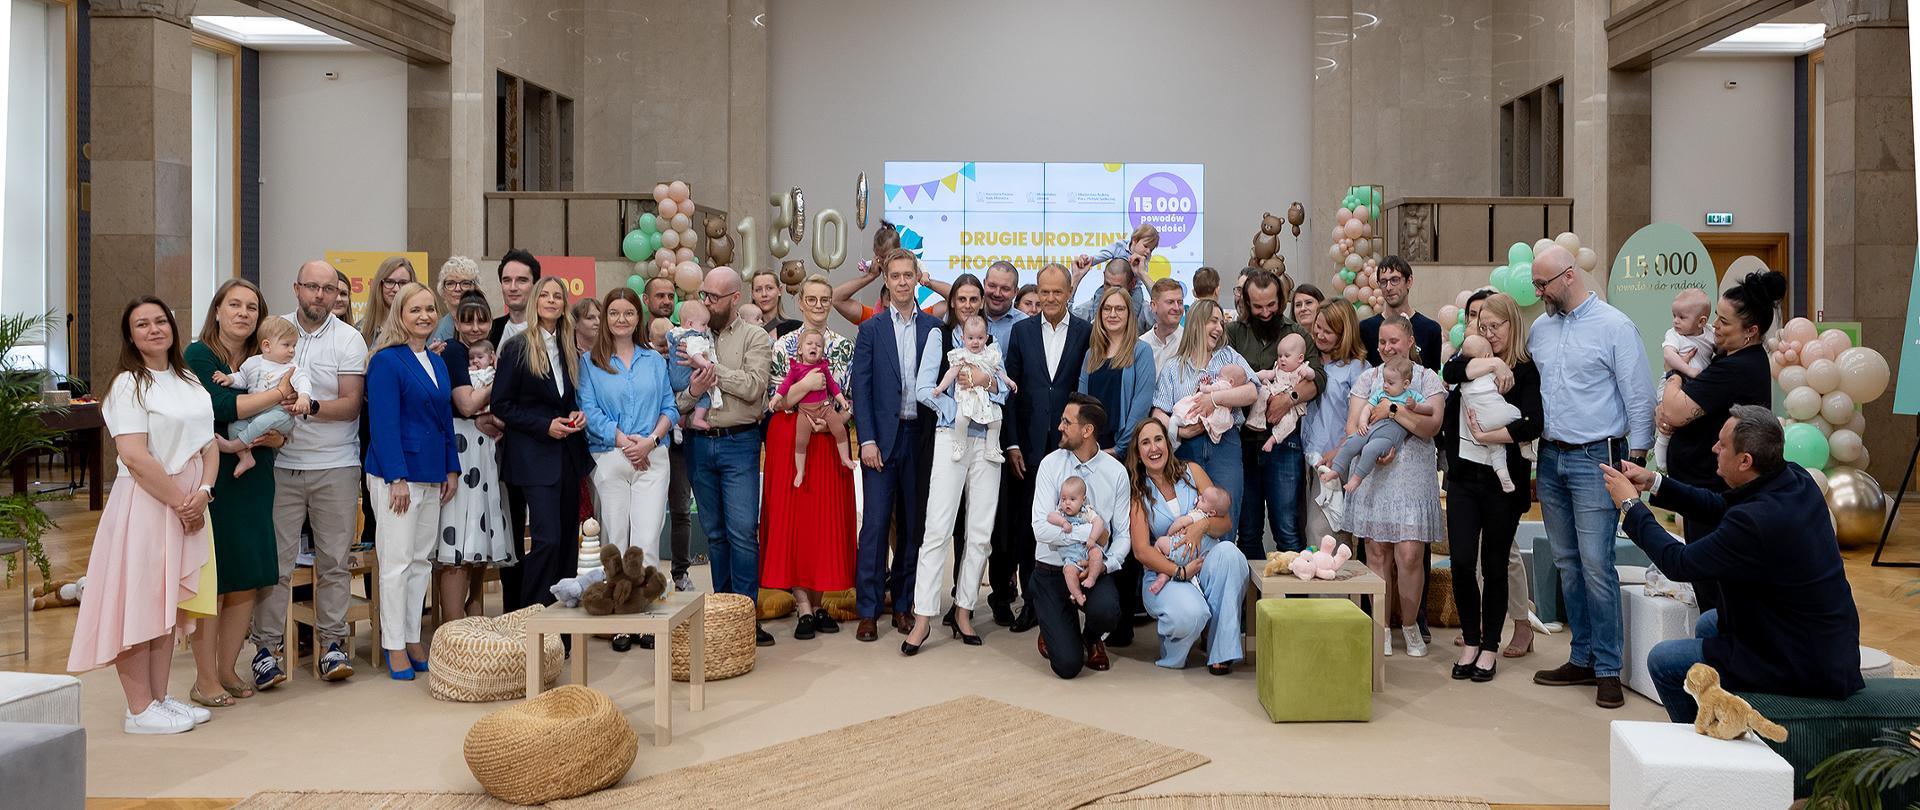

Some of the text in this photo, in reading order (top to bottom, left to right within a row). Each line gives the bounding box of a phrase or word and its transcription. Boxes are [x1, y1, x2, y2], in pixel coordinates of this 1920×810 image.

[1133, 196, 1153, 213] 15
[1156, 196, 1192, 213] 000
[1140, 213, 1185, 225] powodów
[1155, 223, 1187, 233] adości
[959, 231, 1129, 247] DRUGIE URODZINY
[1621, 251, 1698, 279] 15 000
[1615, 280, 1653, 293] powod
